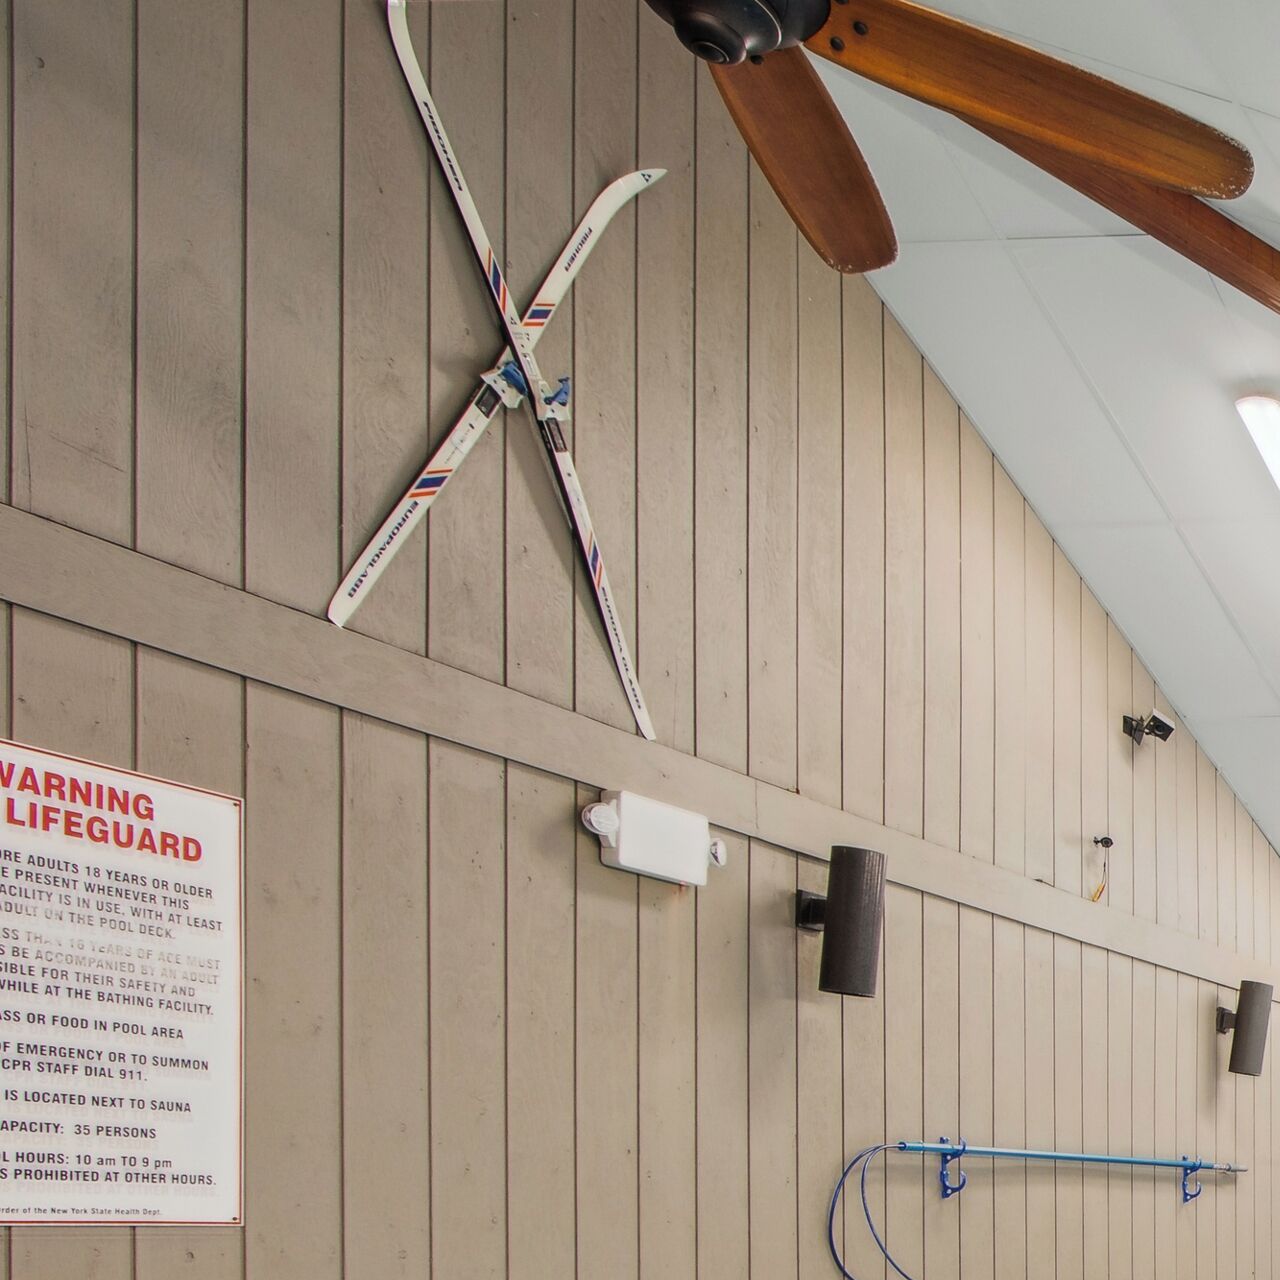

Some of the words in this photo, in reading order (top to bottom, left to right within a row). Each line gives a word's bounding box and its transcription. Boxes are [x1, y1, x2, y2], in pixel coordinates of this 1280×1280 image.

[7, 797, 202, 862] LIFEGUARD
[0, 849, 21, 863] RE
[28, 855, 79, 874] ADULTS
[85, 866, 101, 878] 18
[106, 870, 147, 887] YEARS
[152, 879, 169, 891] OR
[175, 883, 213, 899] OLDER
[15, 869, 78, 890] PRESENT
[84, 882, 157, 904] WHENEVER
[162, 896, 189, 910] THIS
[0, 901, 38, 916] DULT
[44, 908, 63, 920] ON
[68, 911, 94, 926] THE
[100, 917, 134, 932] POOL
[58, 893, 72, 906] IS
[77, 896, 90, 909] IN
[130, 906, 163, 921] WITH
[168, 914, 182, 925] AT
[187, 915, 223, 931] LEAST
[0, 927, 19, 940] SS
[137, 947, 153, 959] OF
[12, 946, 29, 959] BE
[35, 950, 135, 973] ACCOMPANIED
[161, 967, 176, 980] AN
[182, 970, 219, 985] ADULT
[41, 967, 69, 980] FOR
[75, 972, 114, 987] THEIR
[119, 977, 165, 993] SAFETY
[171, 984, 196, 997] AND
[45, 984, 61, 997] AT
[66, 987, 92, 1000] THE
[97, 991, 153, 1008] BATHING
[158, 999, 214, 1016] FACILITY.
[0, 1009, 21, 1022] SS
[27, 1012, 46, 1025] OR
[52, 1015, 88, 1029] FOOD
[94, 1020, 107, 1031] IN
[113, 1022, 146, 1036] POOL
[151, 1027, 184, 1039] AREA
[0, 1041, 11, 1052] F
[17, 1042, 103, 1061] EMERGENCY
[109, 1052, 126, 1064] OR
[131, 1054, 147, 1065] TO
[152, 1055, 209, 1071] SUMMON
[2, 1059, 31, 1071] CPR
[37, 1061, 79, 1075] STAFF
[84, 1066, 114, 1079] DIAL
[119, 1069, 148, 1081] 911.
[5, 1089, 18, 1101] IS
[24, 1091, 86, 1106] LOCATED
[91, 1096, 125, 1108] NEXT
[129, 1098, 145, 1109] TO
[150, 1100, 191, 1112] SAUNA
[74, 1124, 90, 1136] 35
[96, 1125, 156, 1139] PERSONS
[15, 1151, 69, 1165] HOURS:
[76, 1154, 91, 1165] 10
[97, 1157, 116, 1167] am
[121, 1156, 136, 1167] TO
[142, 1157, 149, 1167] 9
[154, 1158, 172, 1170] pm
[14, 1168, 99, 1182] PROHIBITED
[104, 1171, 120, 1182] AT
[125, 1171, 166, 1184] OTHER
[171, 1174, 216, 1185] HOURS.
[91, 1207, 112, 1215] State
[115, 1207, 140, 1215] Health
